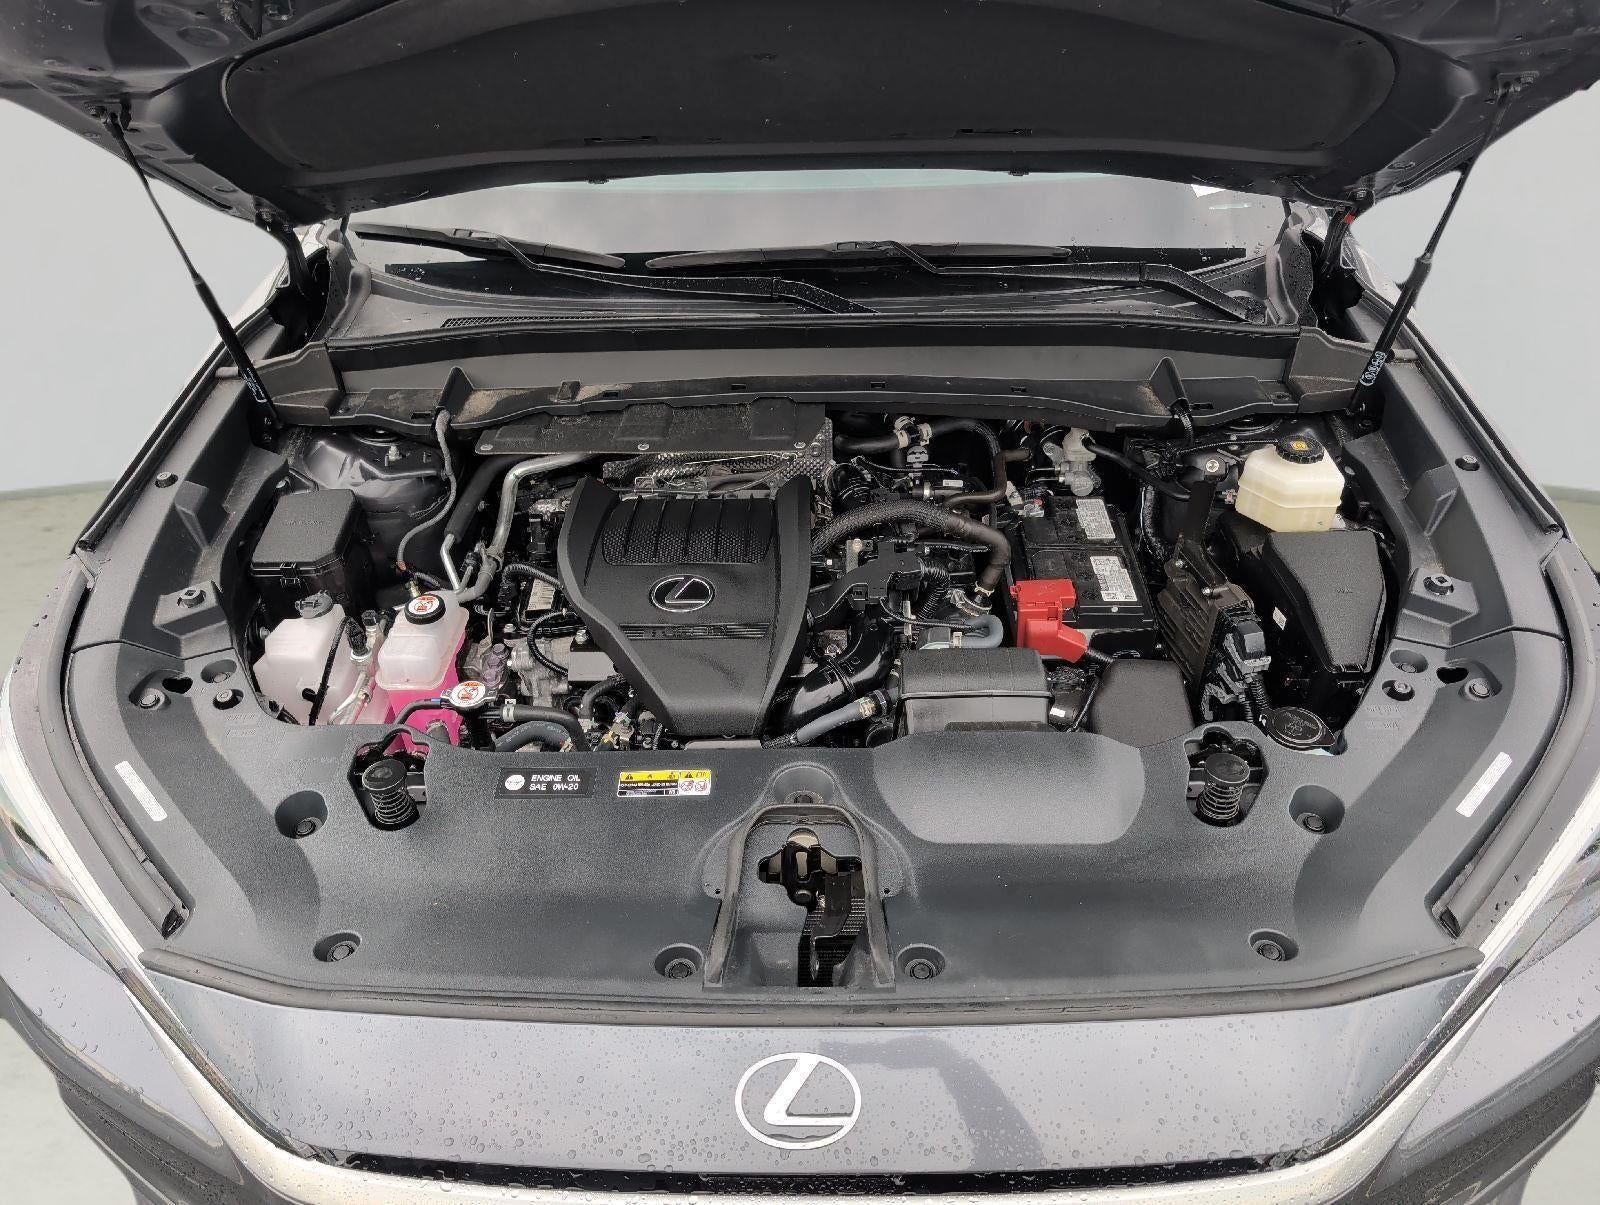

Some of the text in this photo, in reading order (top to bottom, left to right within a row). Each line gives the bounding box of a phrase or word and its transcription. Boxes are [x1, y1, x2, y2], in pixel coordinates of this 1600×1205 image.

[530, 774, 581, 782] ENGINE OIL
[529, 783, 548, 791] SAE
[552, 783, 579, 791] 0W-20
